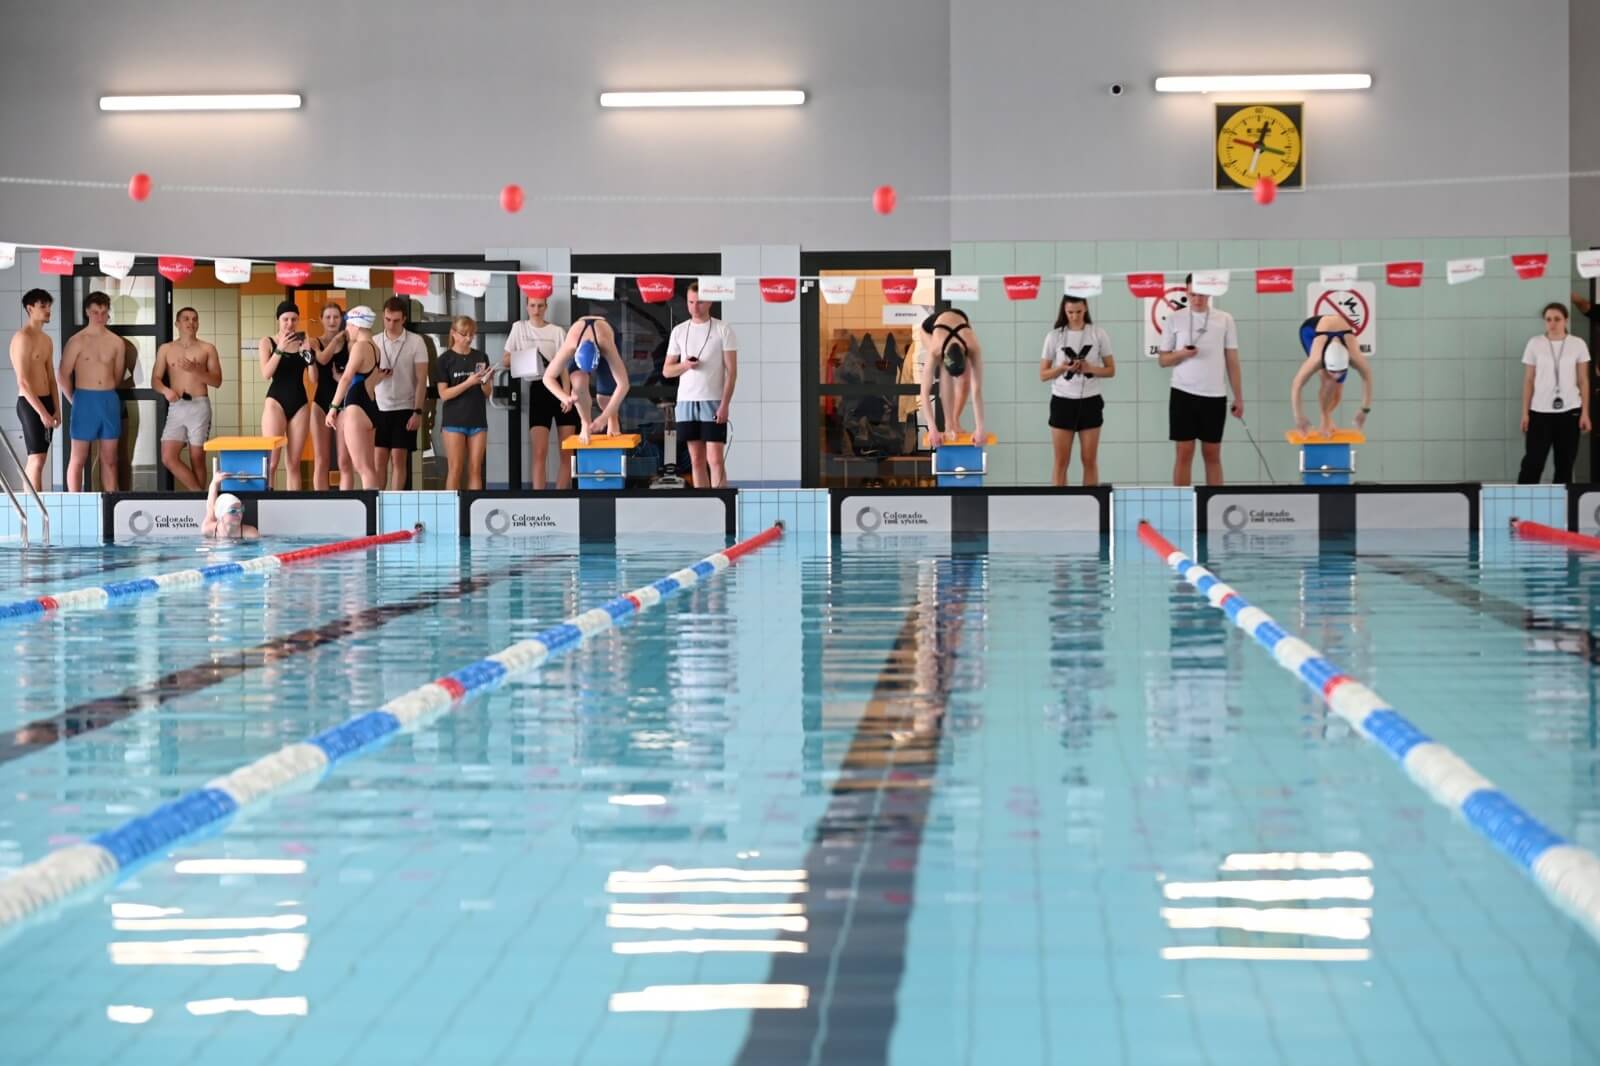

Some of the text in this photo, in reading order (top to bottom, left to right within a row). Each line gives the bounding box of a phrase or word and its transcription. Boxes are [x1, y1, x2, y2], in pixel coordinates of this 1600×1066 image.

[154, 514, 195, 523] Colorado
[511, 513, 551, 522] Colorado
[882, 511, 923, 519] Colorado
